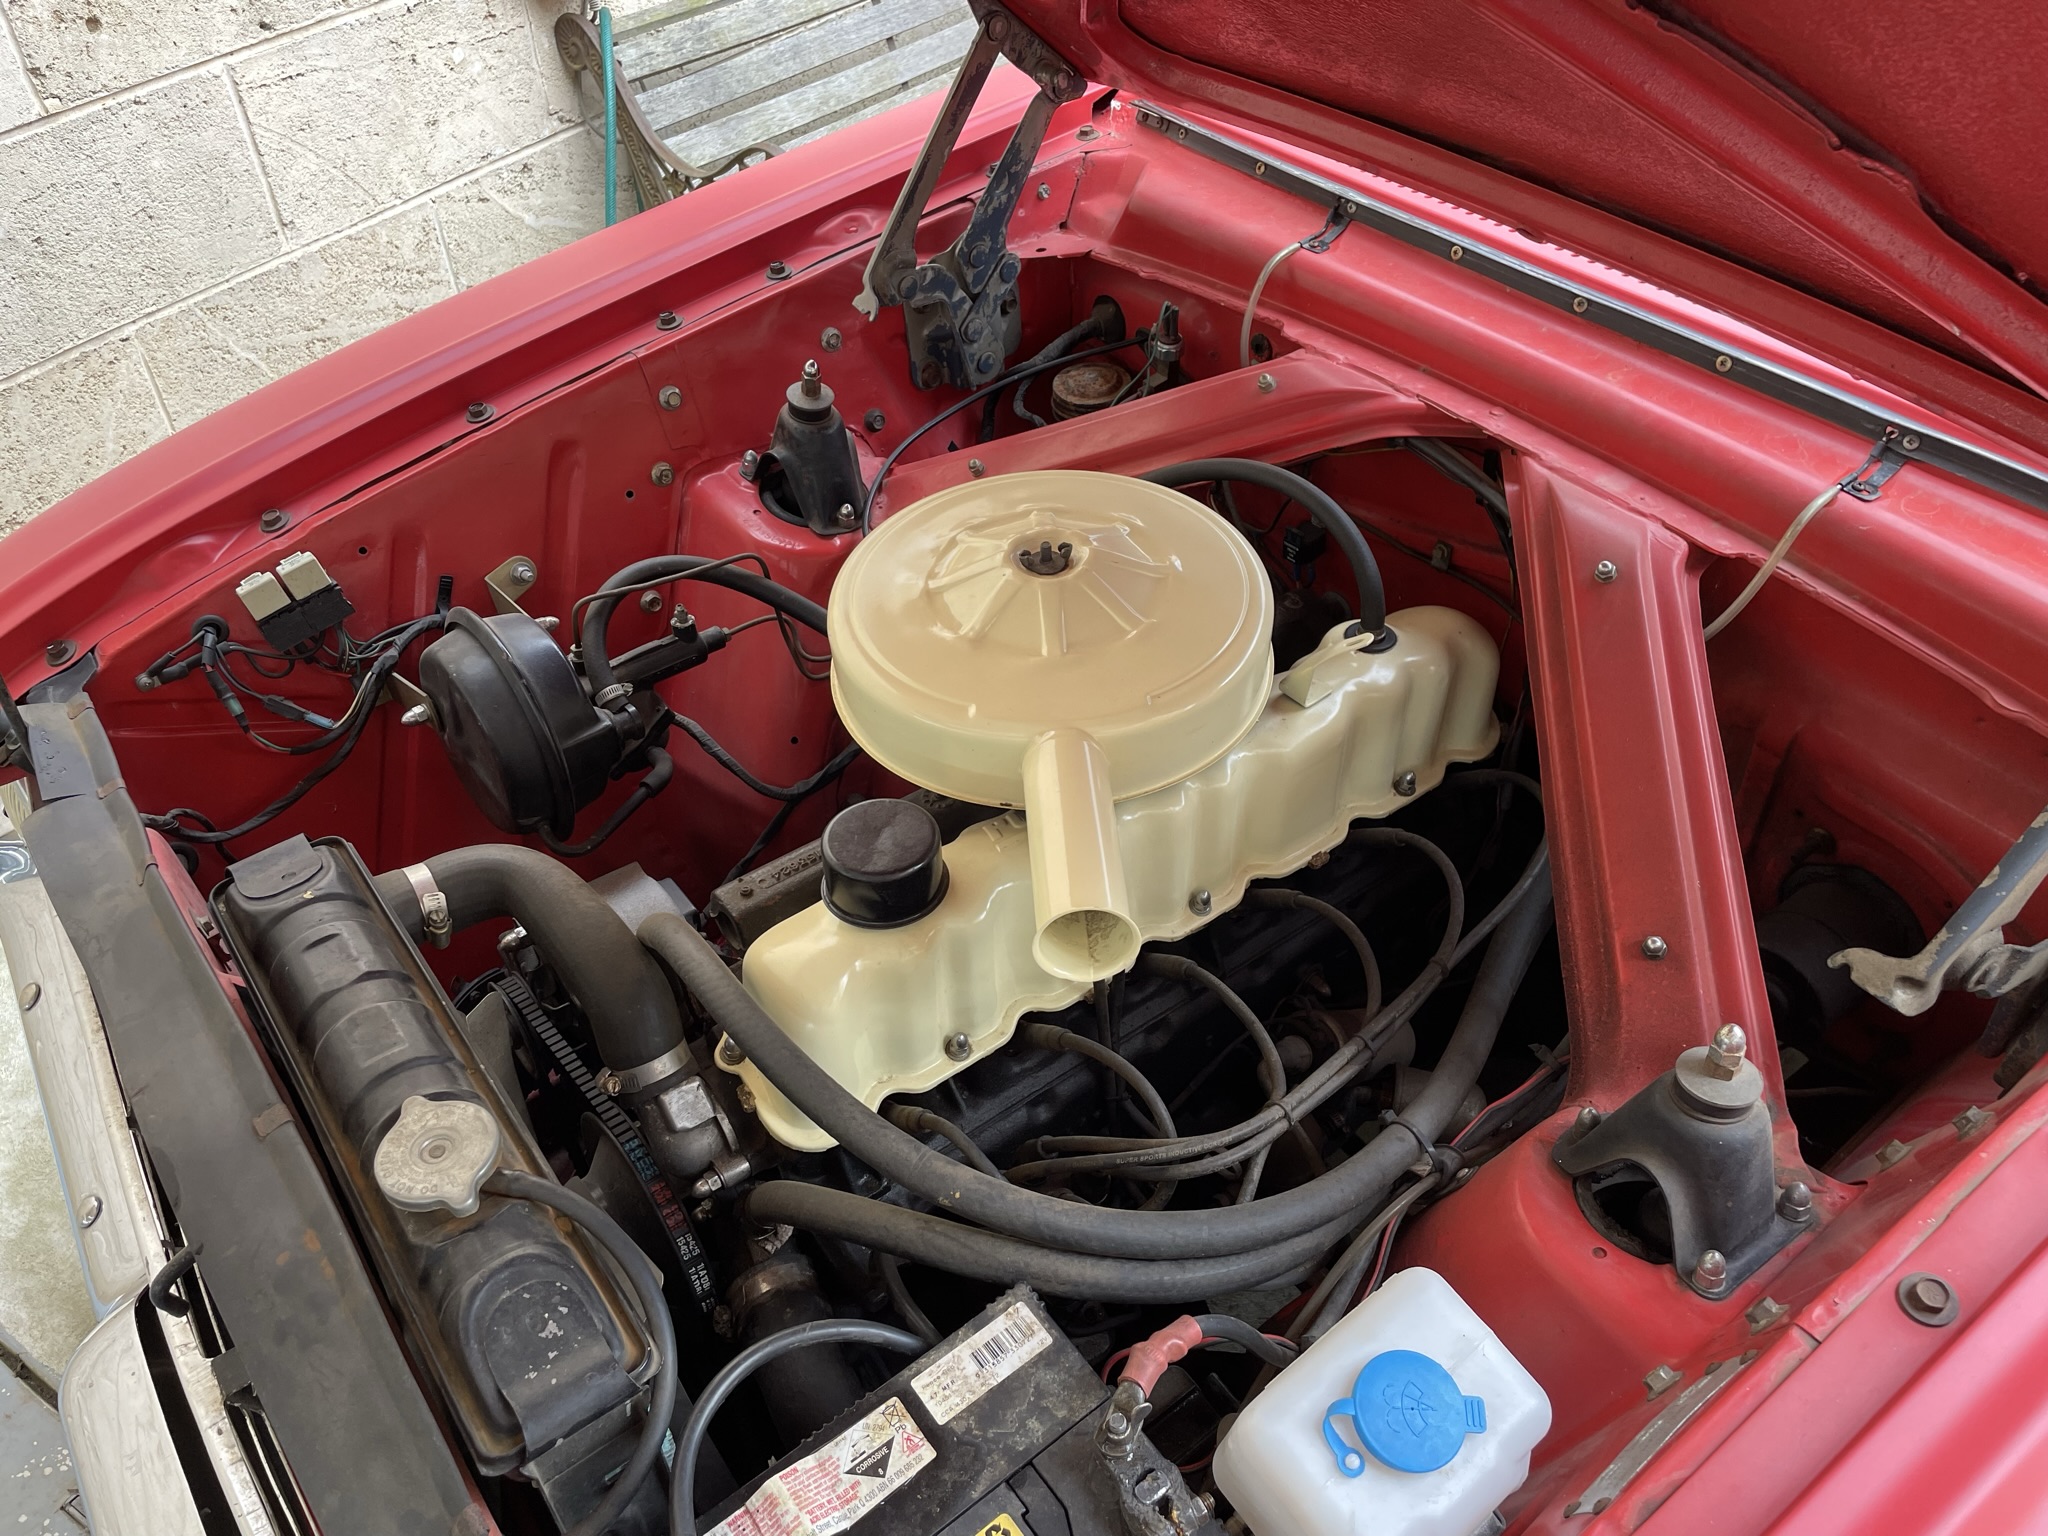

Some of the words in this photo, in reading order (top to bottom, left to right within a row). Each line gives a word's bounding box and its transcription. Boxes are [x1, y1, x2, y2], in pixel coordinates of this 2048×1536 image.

[676, 1236, 692, 1260] 15425
[895, 1423, 907, 1434] Pb
[856, 1446, 890, 1474] CORROSIVE
[779, 1466, 799, 1481] POISON
[862, 1488, 878, 1503] 4300
[874, 1480, 889, 1493] ABN
[892, 1467, 905, 1479] 009
